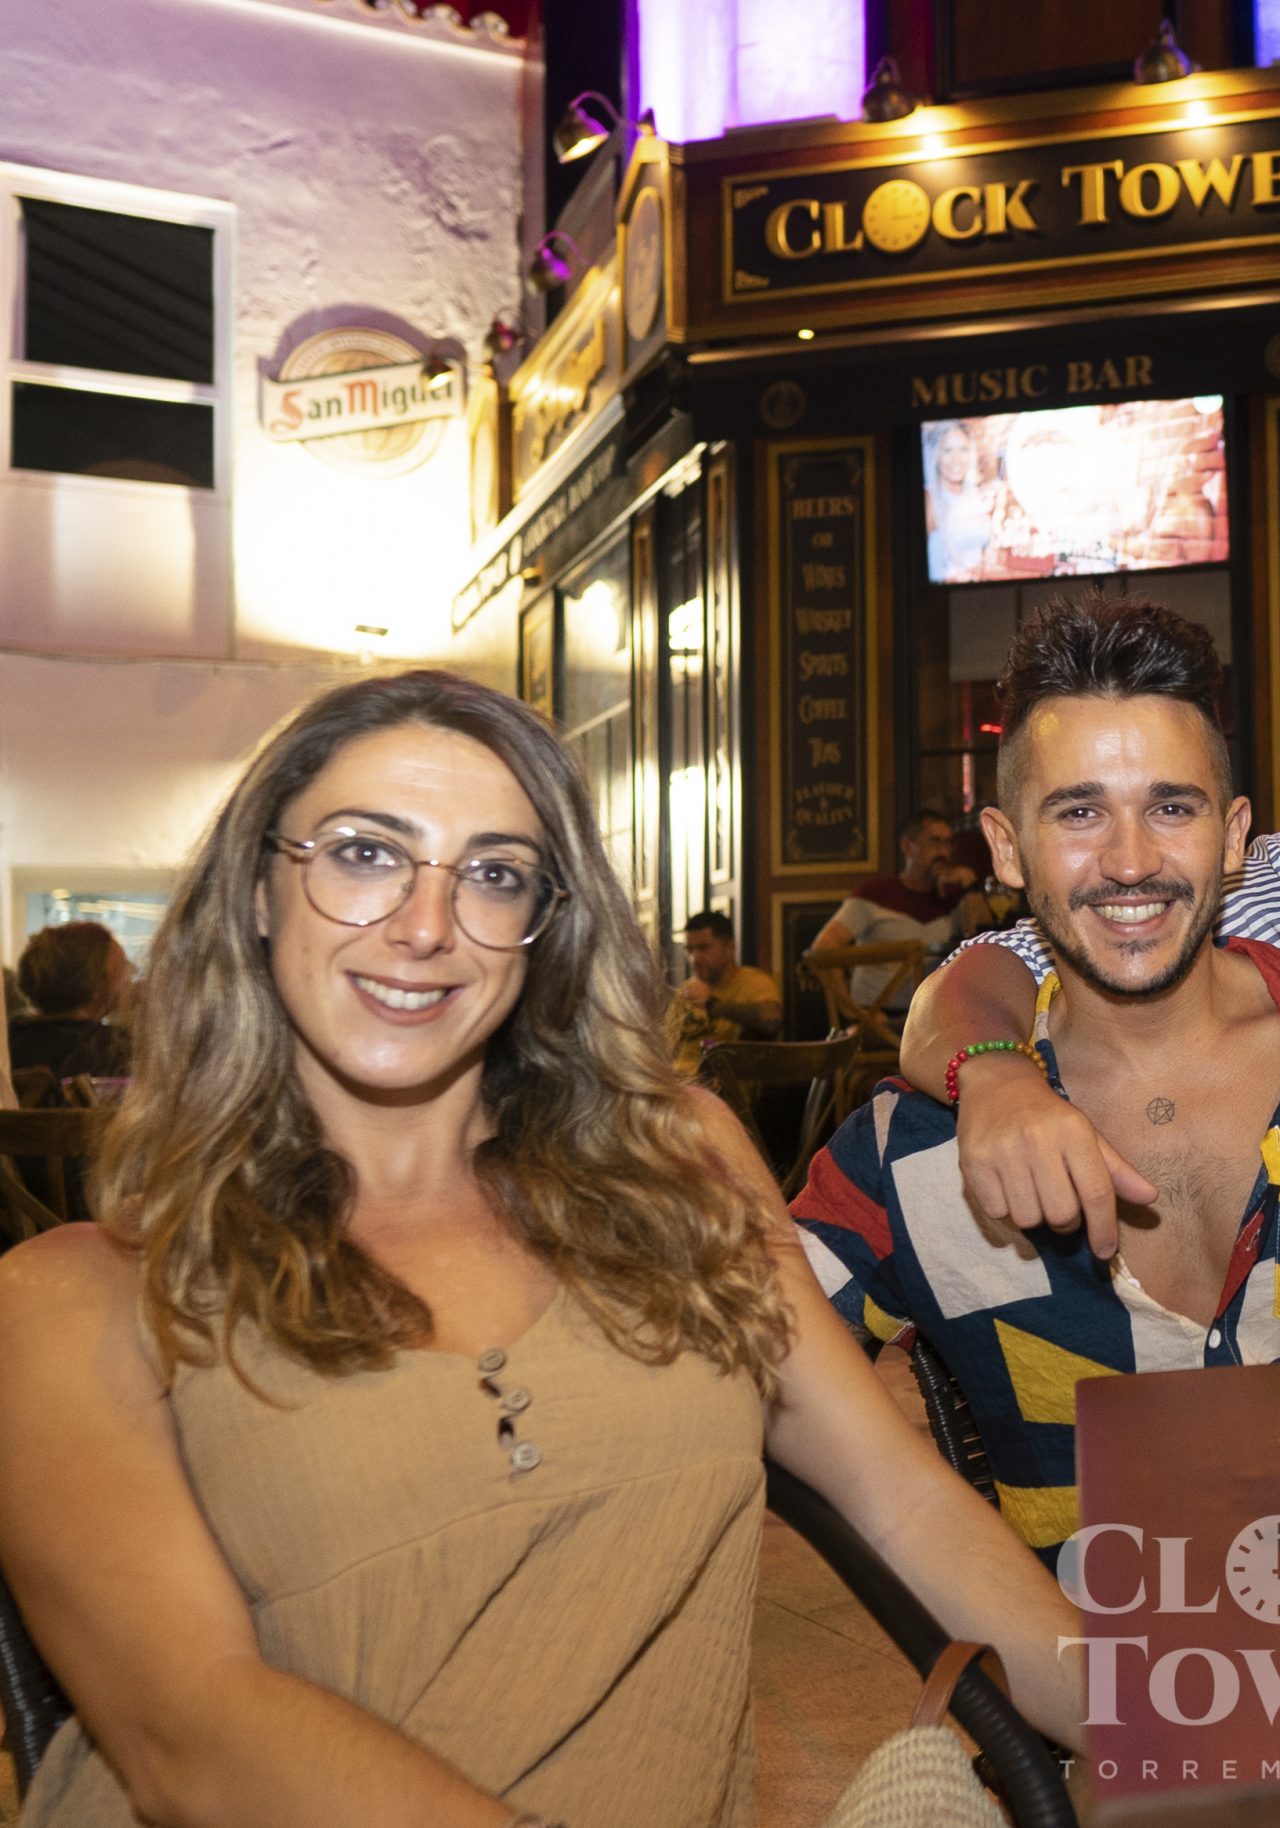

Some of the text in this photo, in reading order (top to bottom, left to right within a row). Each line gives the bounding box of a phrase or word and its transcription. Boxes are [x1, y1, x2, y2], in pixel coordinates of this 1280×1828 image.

[765, 178, 1040, 261] CLOCK
[911, 355, 1154, 409] MUSIC BAR
